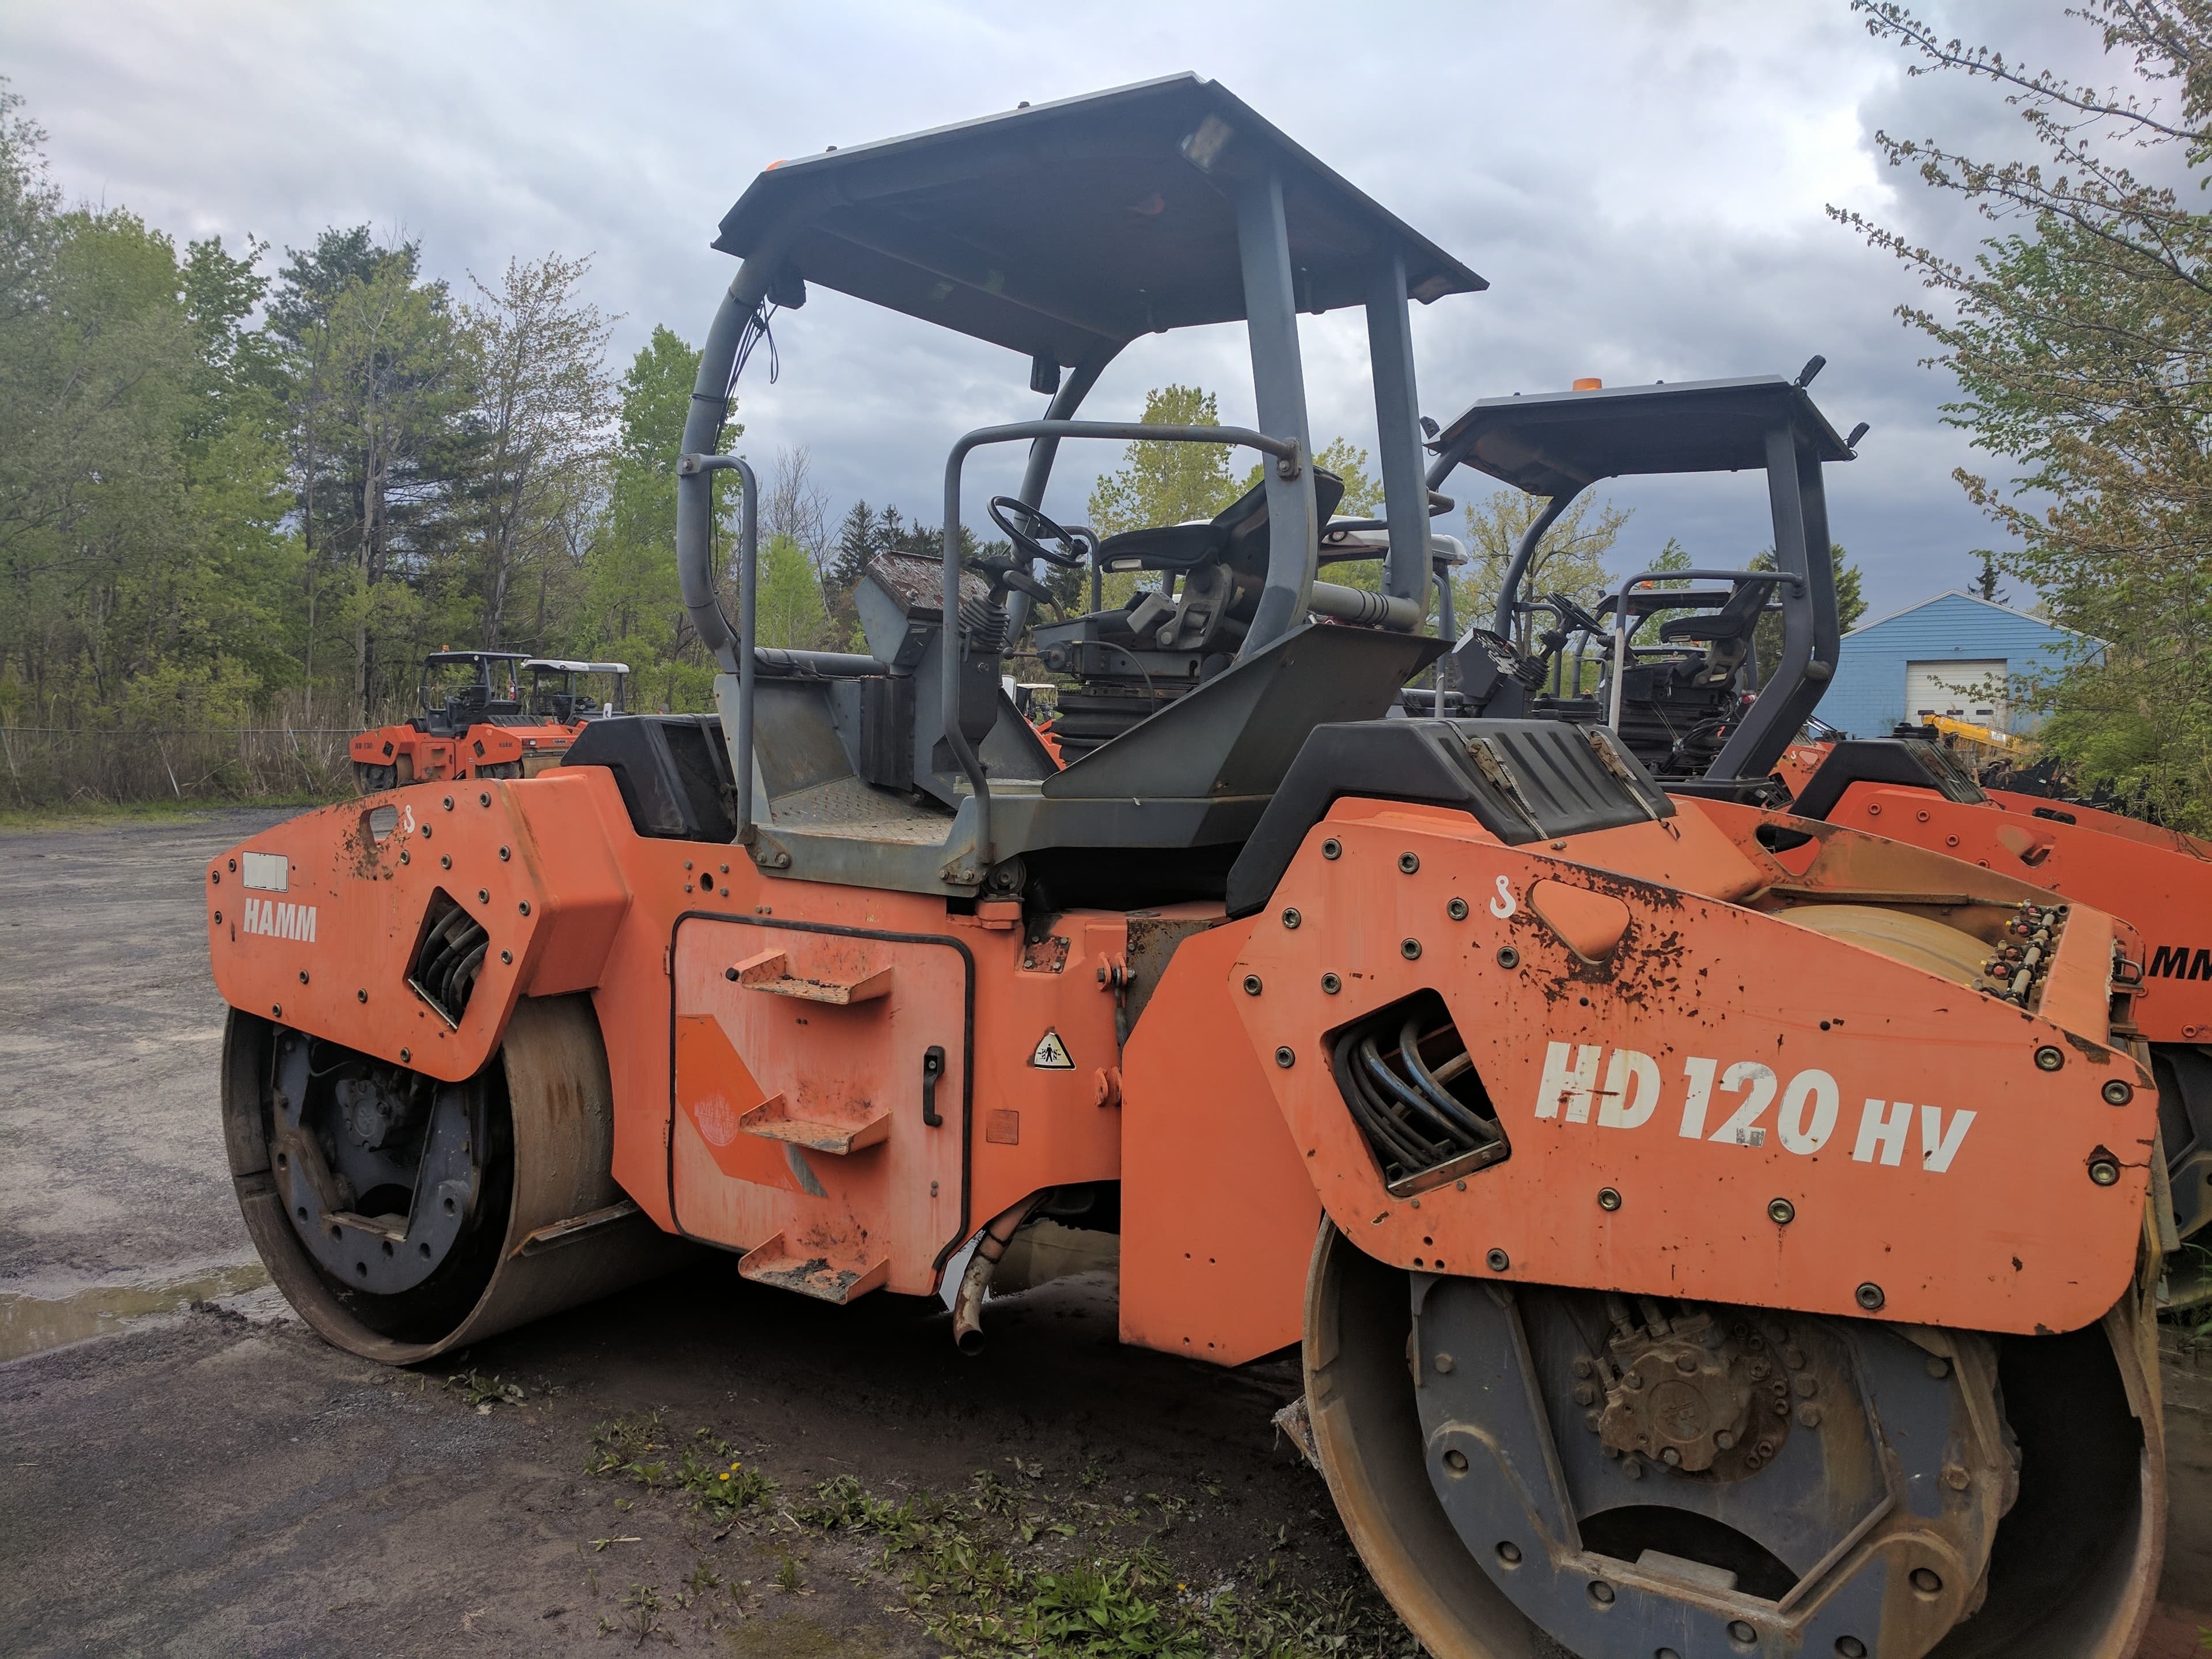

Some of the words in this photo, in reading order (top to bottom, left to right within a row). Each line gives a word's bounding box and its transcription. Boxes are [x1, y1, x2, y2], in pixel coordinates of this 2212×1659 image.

[244, 897, 317, 942] HAMM
[2142, 945, 2212, 981] MM
[1535, 1041, 1661, 1129] HD
[1679, 1056, 1839, 1155] 120
[1851, 1098, 1977, 1173] HV
